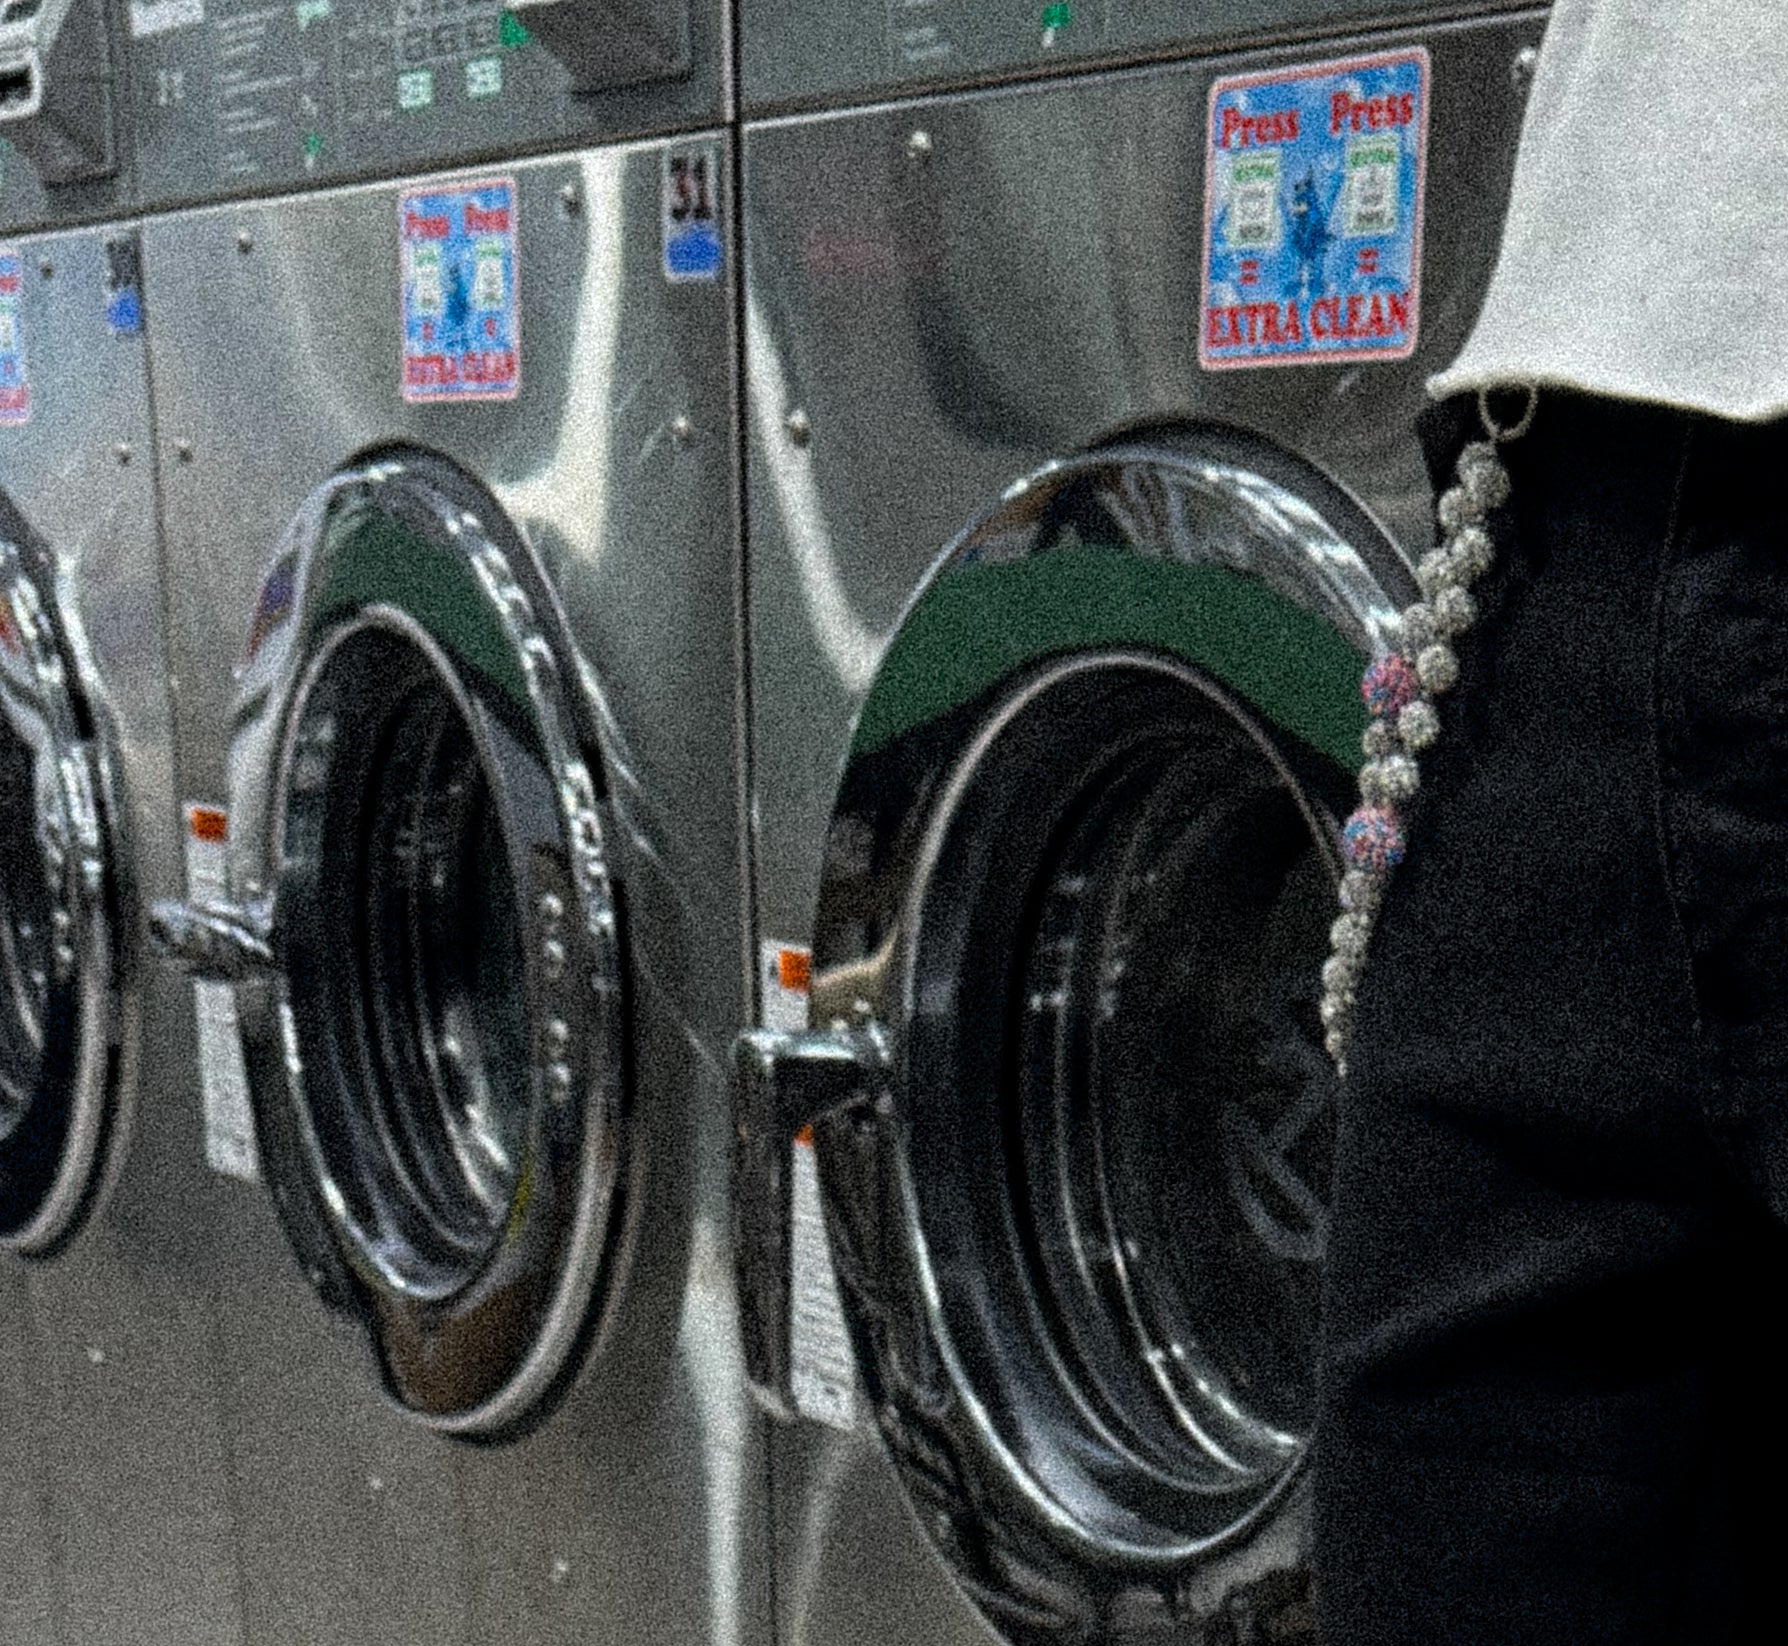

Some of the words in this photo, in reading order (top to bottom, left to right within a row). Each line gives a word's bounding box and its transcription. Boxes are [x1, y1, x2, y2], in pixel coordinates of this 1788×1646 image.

[1221, 107, 1299, 148] Press
[1329, 90, 1413, 135] Press
[1206, 301, 1301, 347] EXTRA
[1309, 291, 1410, 340] CLEAN
